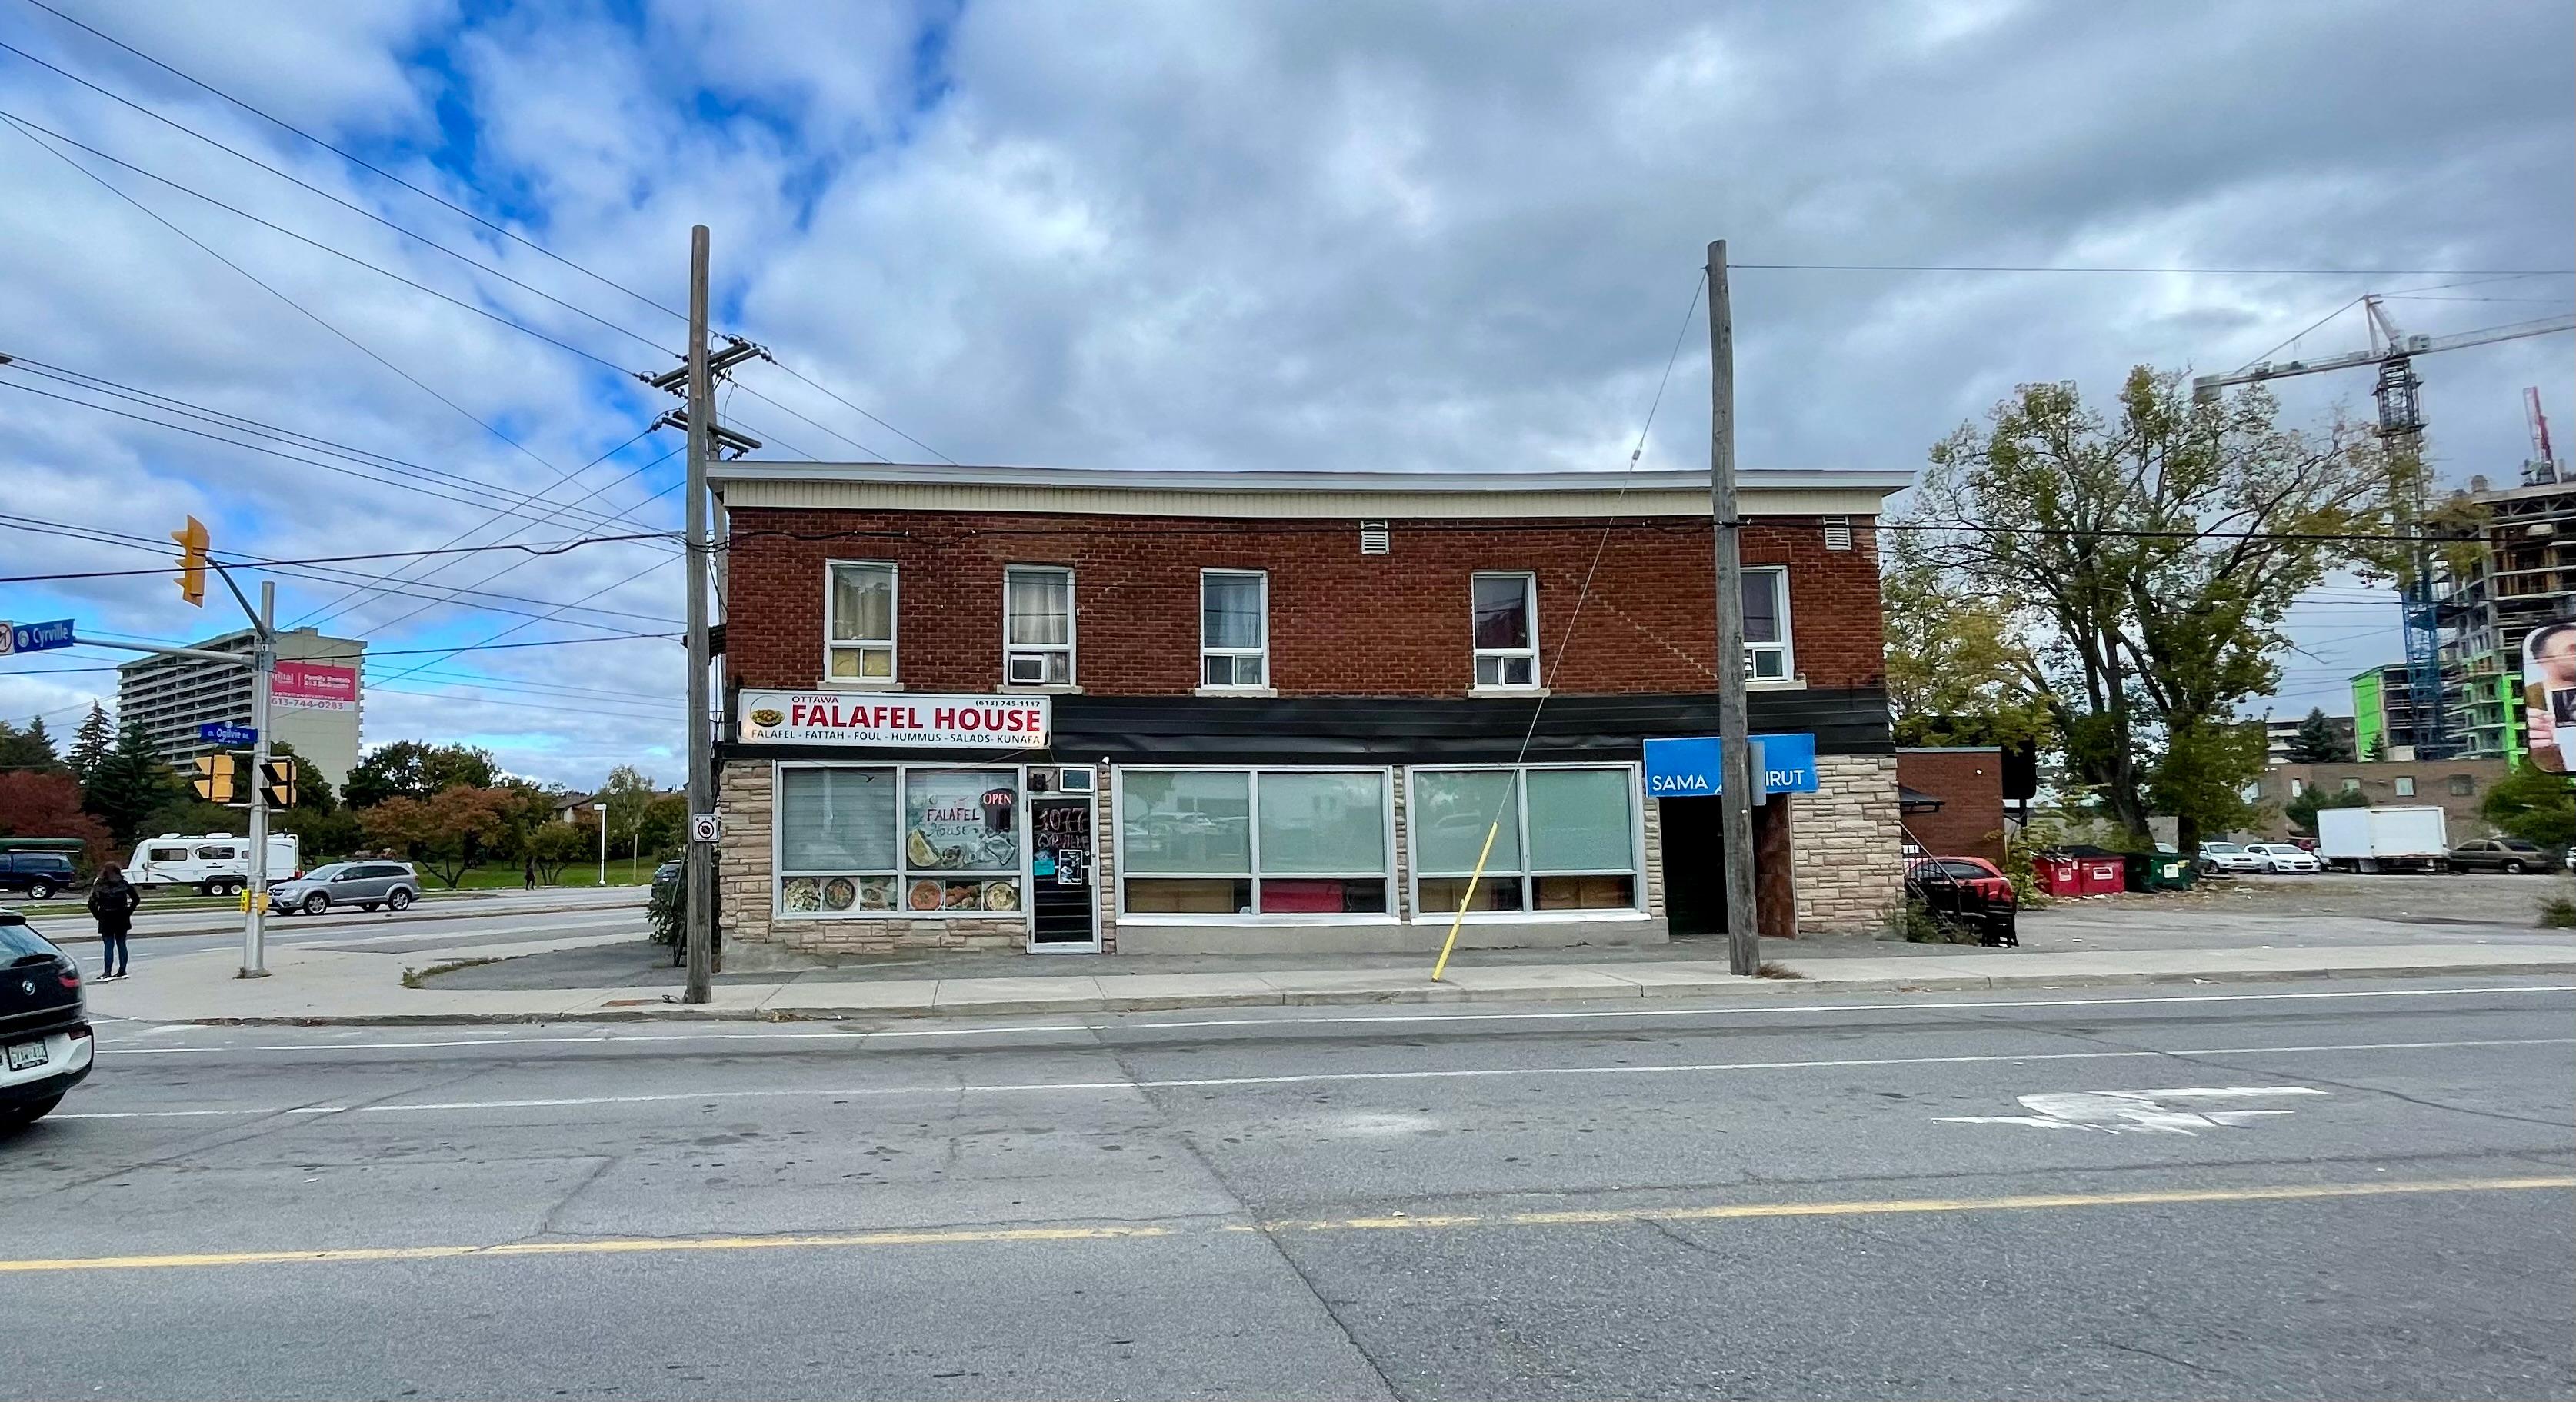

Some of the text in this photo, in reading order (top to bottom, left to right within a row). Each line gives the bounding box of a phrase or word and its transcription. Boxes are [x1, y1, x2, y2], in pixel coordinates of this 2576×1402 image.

[32, 623, 68, 648] Cyrville
[271, 698, 344, 710] 613-744-0283
[791, 704, 1041, 731] FALAFEL HOUSE
[751, 729, 795, 739] FALAFEL
[805, 731, 845, 740] FATTAH
[854, 731, 881, 741] FOUL
[891, 732, 941, 742] HUMMUS
[997, 734, 1040, 744] KUNAFA
[1652, 770, 1805, 791] SAMA IRUT
[983, 793, 1012, 805] OPEN
[927, 808, 981, 821] FALAFEL
[1037, 808, 1087, 833] 1077
